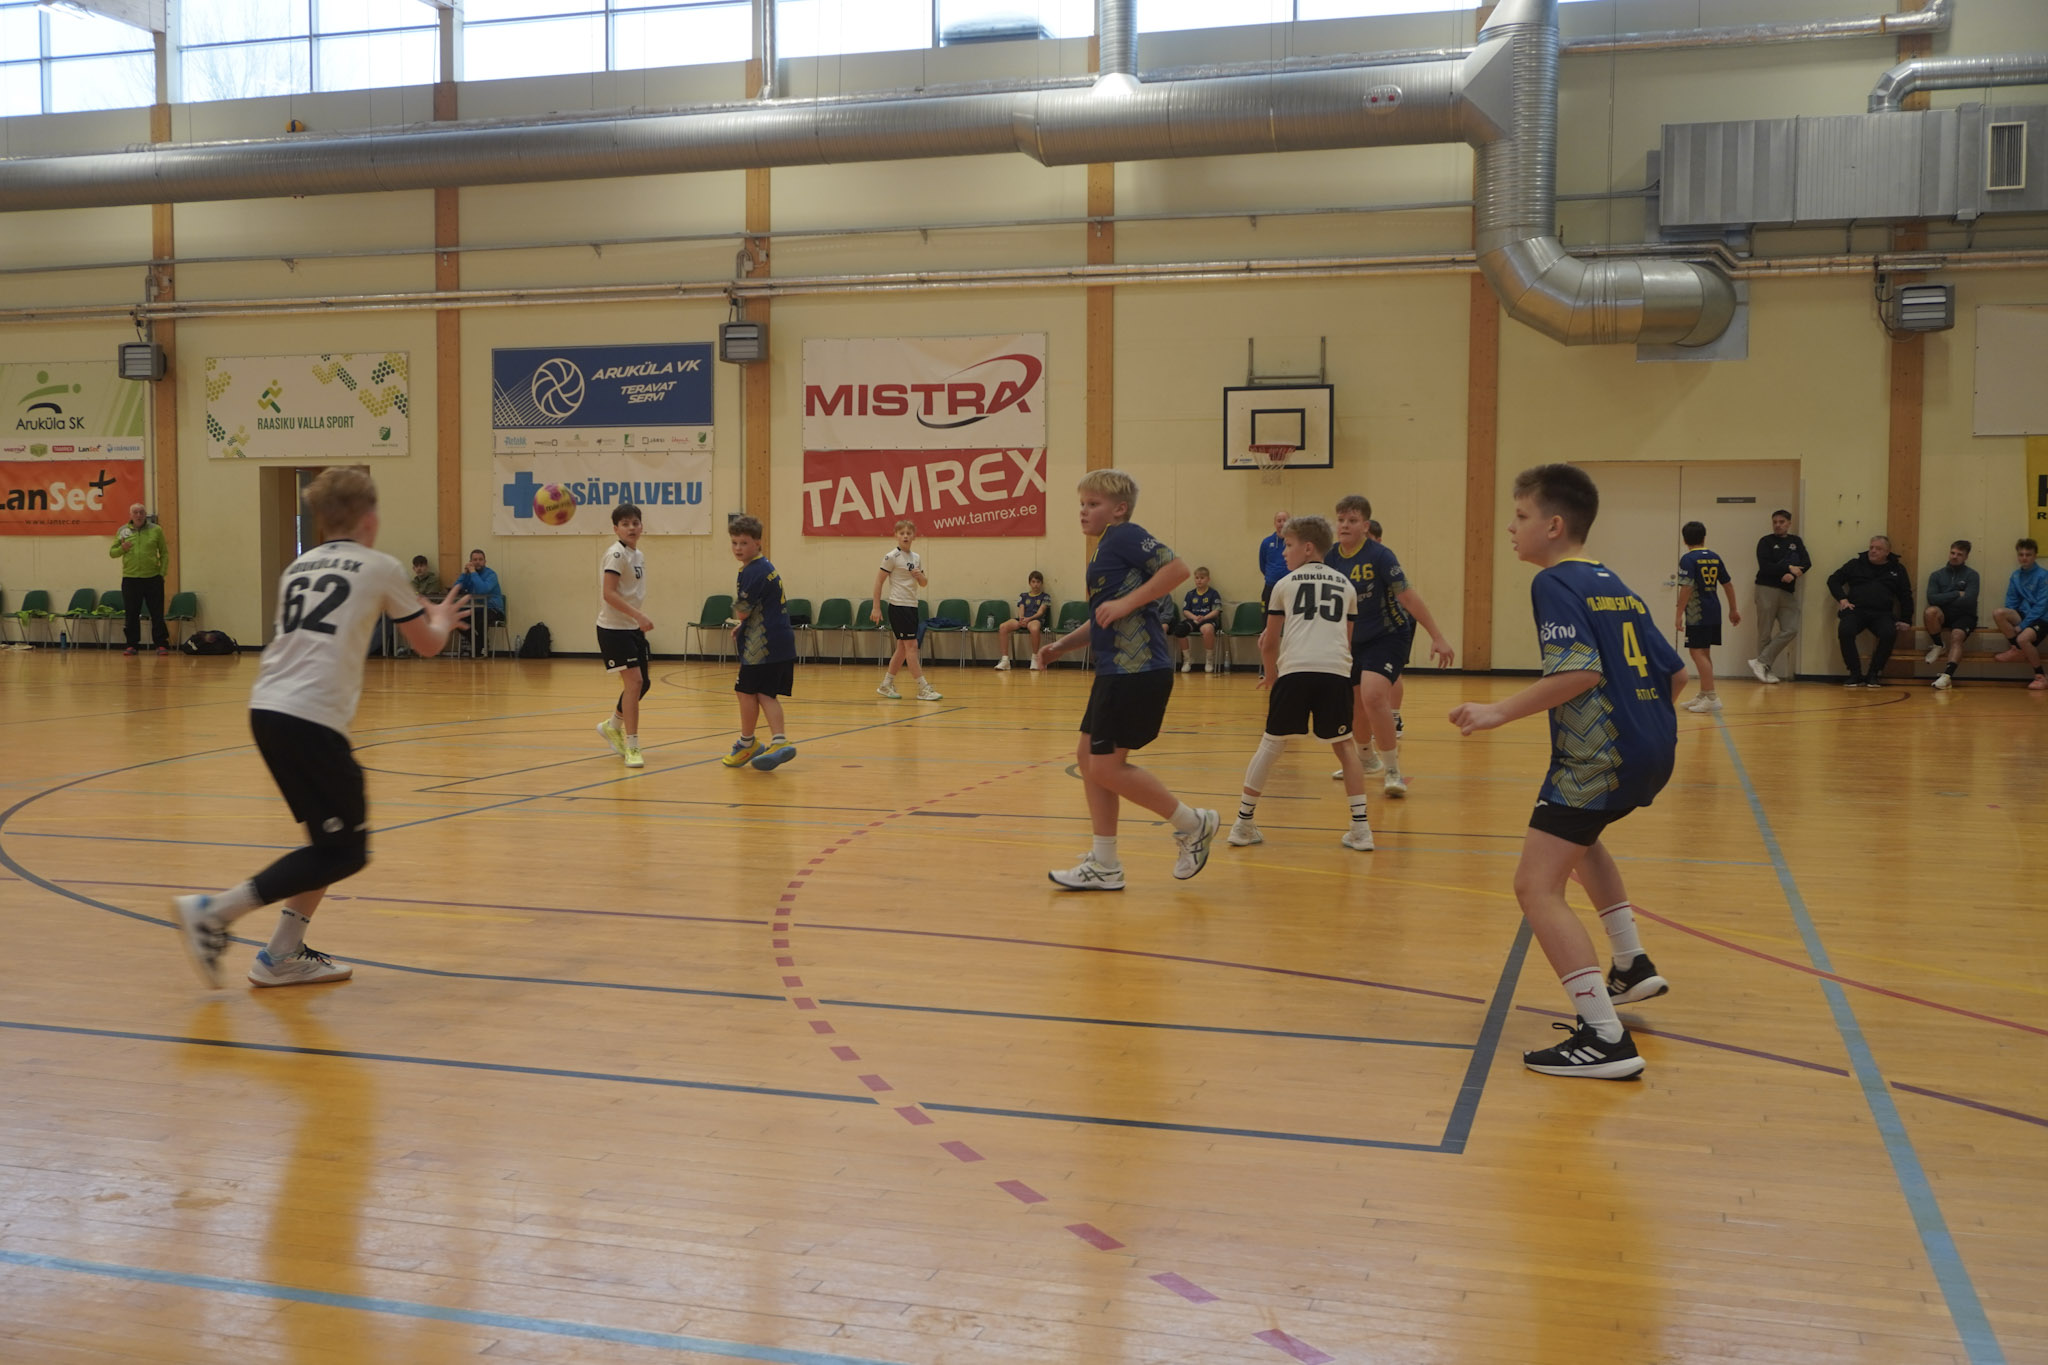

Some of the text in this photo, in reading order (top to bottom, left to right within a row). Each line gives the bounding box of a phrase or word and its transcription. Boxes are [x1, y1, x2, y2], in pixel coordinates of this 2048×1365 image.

[591, 359, 702, 380] ARUKÜLA VK
[620, 381, 677, 395] TERAVAT
[627, 391, 666, 404] SERVI
[805, 381, 1032, 416] MISTRA
[16, 416, 85, 430] Aruküla SK
[257, 415, 355, 430] RAASIKU VALLA SPORT
[803, 448, 1047, 528] TAMREX
[933, 503, 1038, 529] www.tamrex.ee
[1350, 563, 1375, 582] 46
[283, 573, 352, 636] 62
[1292, 583, 1344, 623] 45
[1622, 621, 1649, 679] 4
